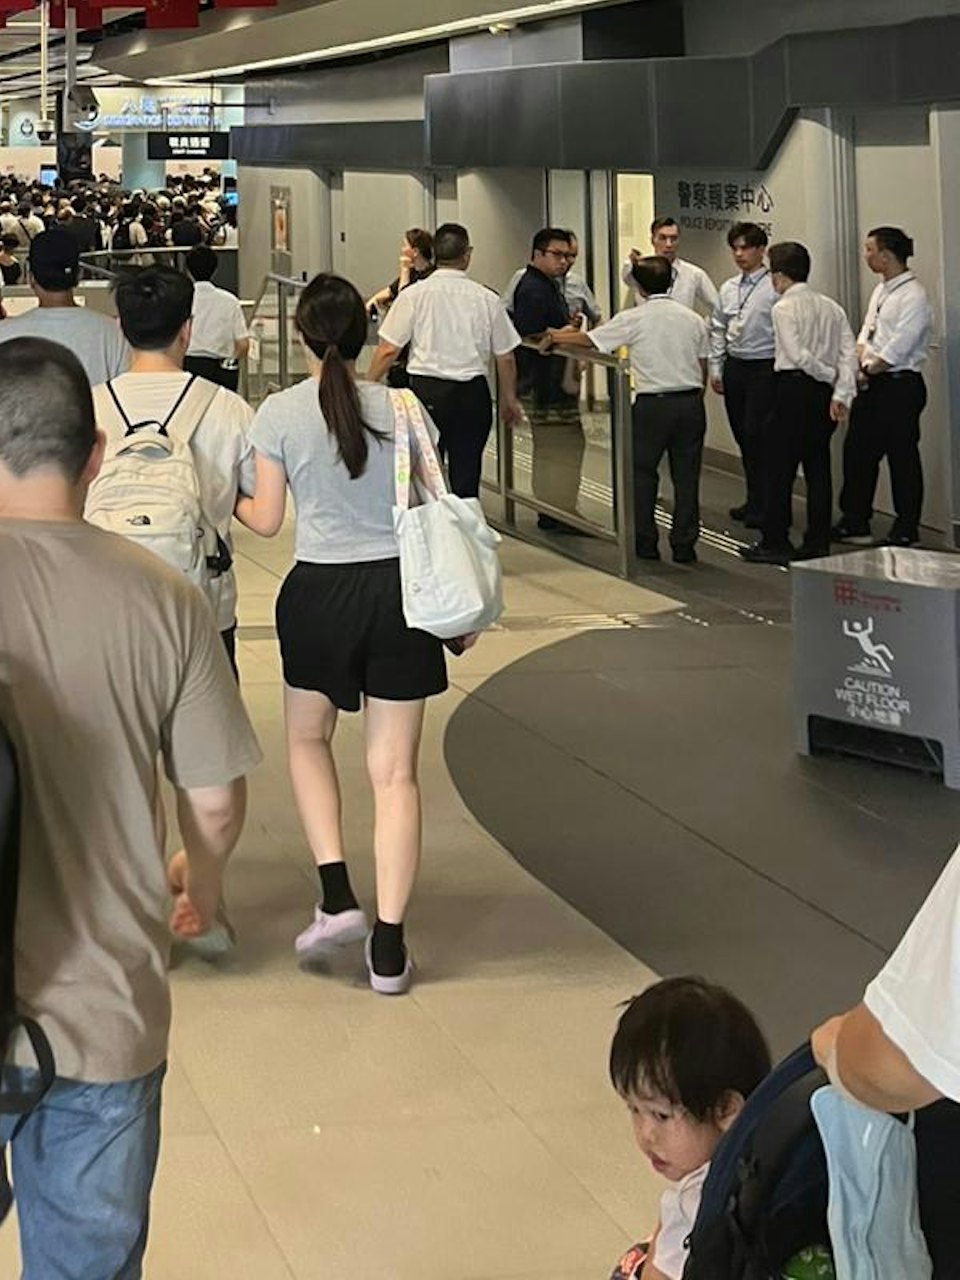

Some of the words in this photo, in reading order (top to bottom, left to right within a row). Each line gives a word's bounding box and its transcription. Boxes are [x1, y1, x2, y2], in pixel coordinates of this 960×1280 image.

[678, 181, 774, 213] 警察報案中心
[844, 677, 900, 698] CAUTION
[835, 688, 863, 704] WET
[865, 693, 909, 713] FLOOR
